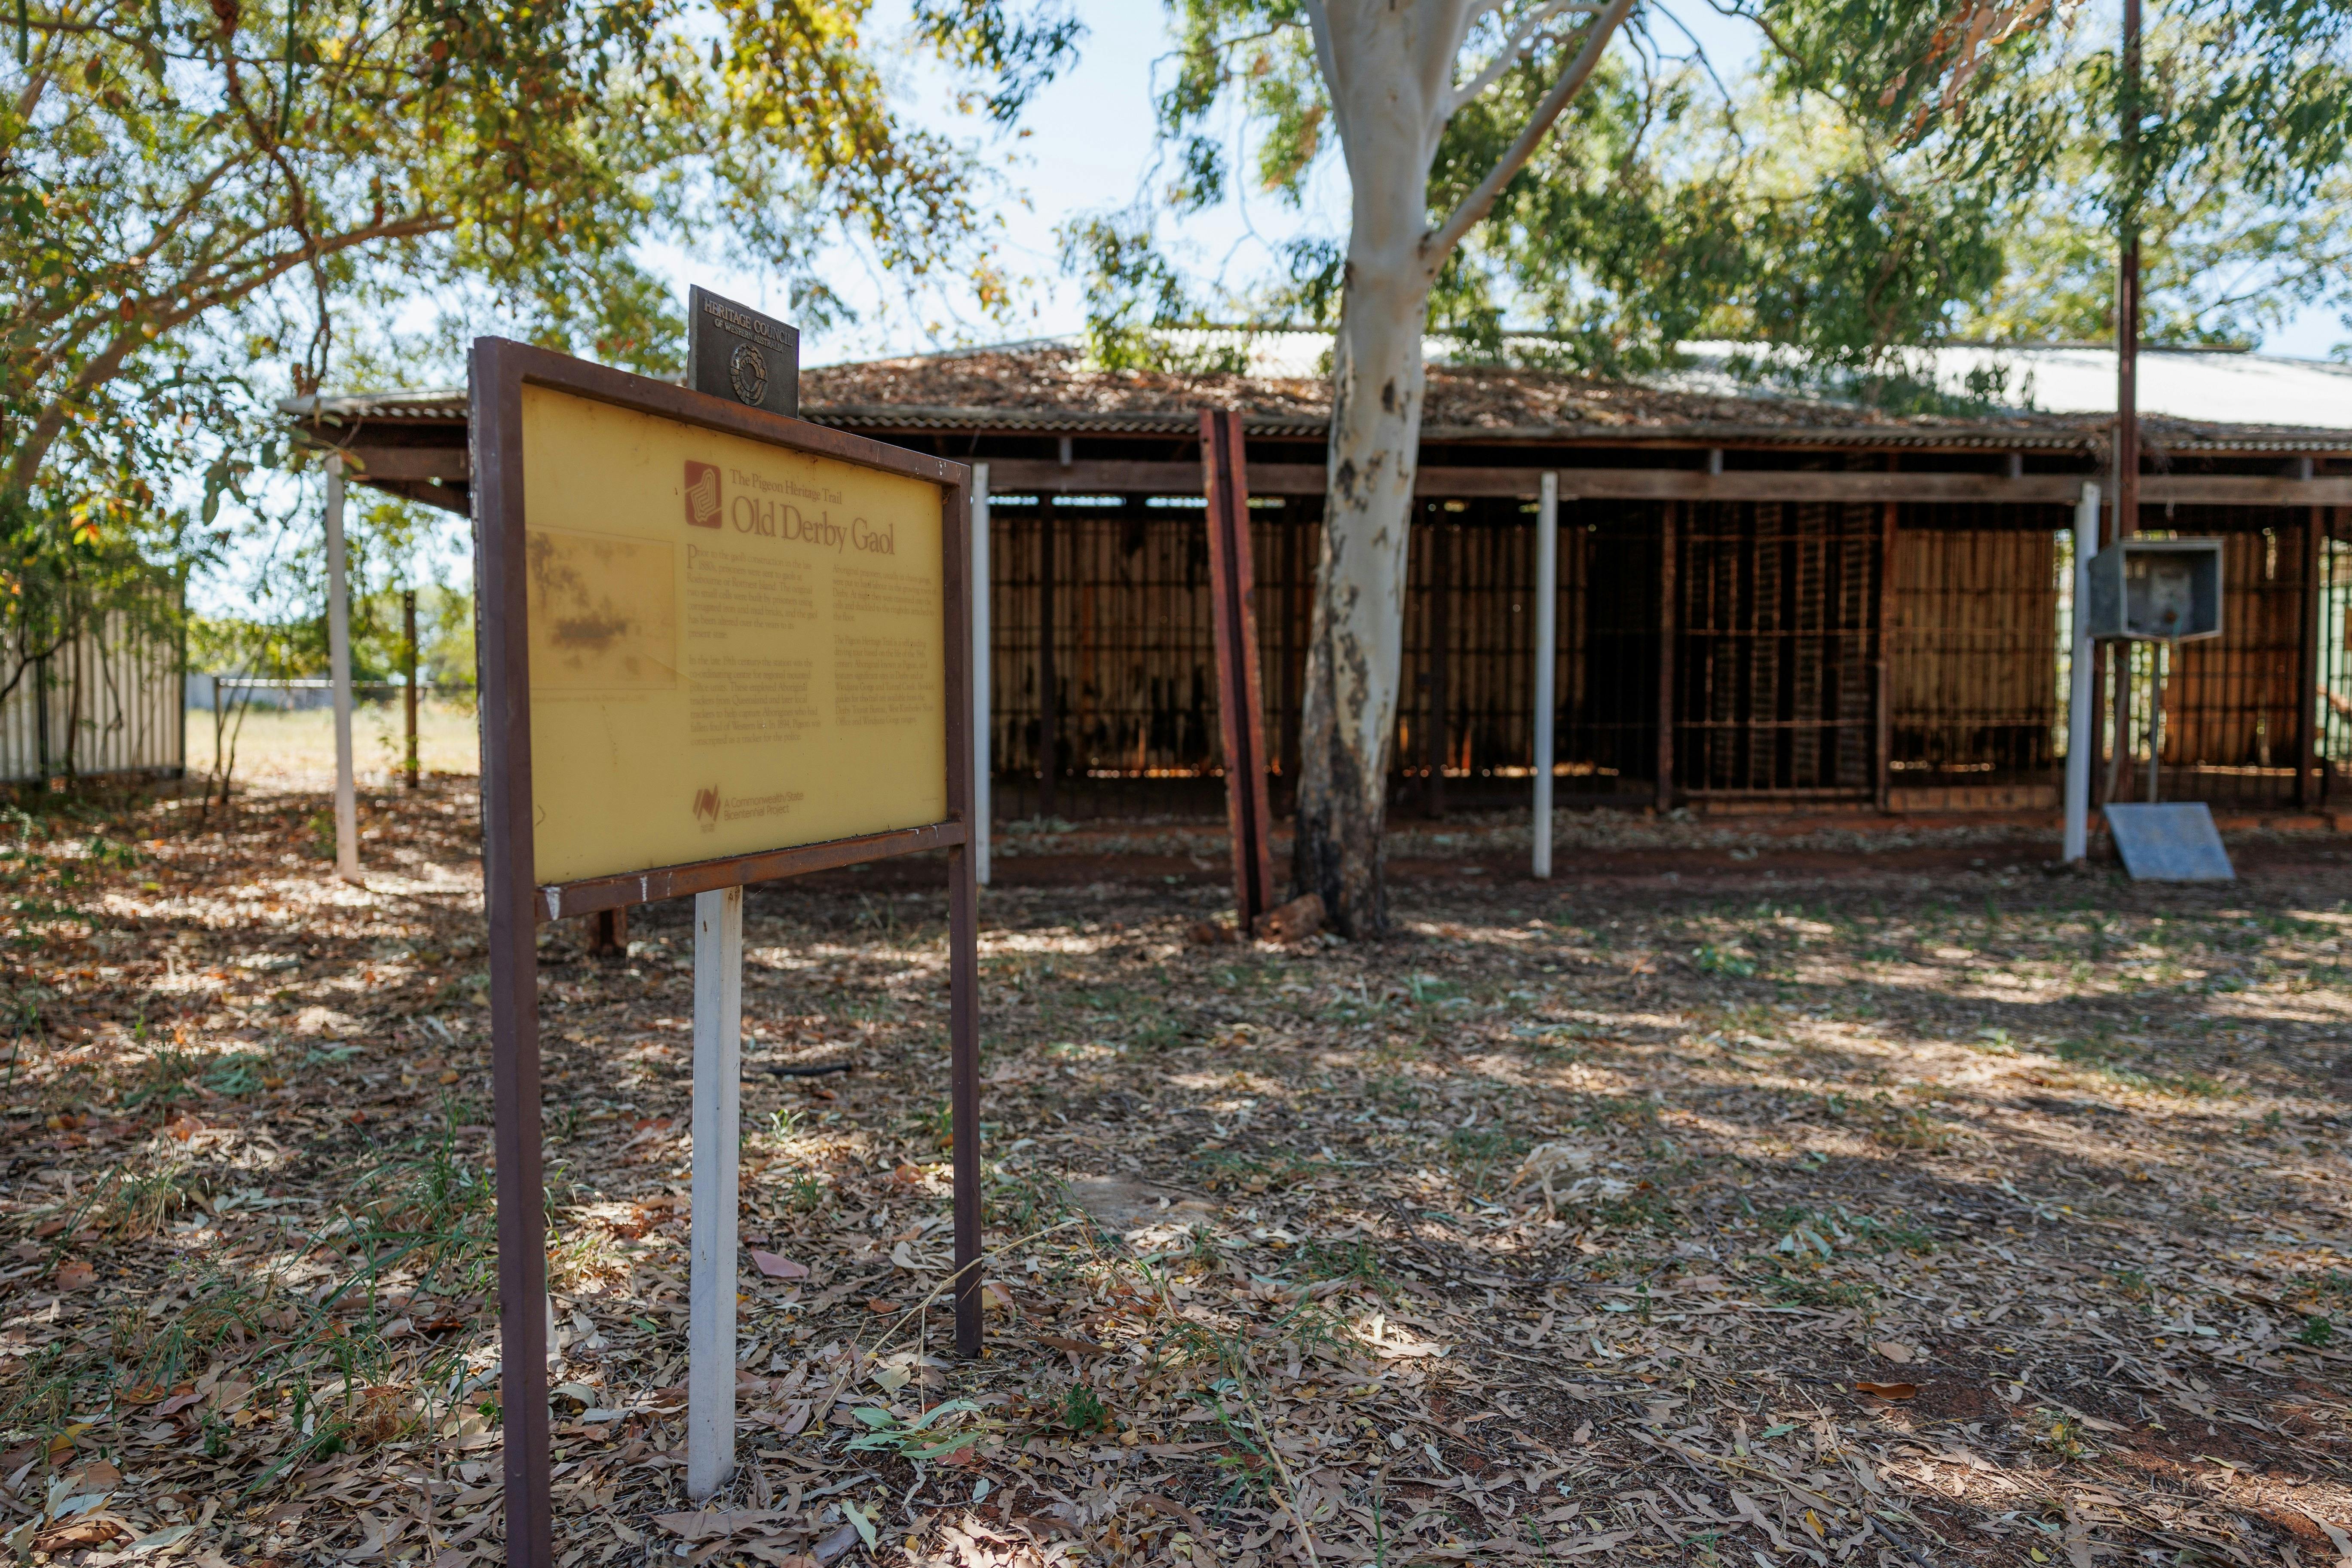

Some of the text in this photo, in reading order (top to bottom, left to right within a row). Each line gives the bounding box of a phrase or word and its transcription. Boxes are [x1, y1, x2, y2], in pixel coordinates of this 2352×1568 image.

[703, 297, 793, 346] HERITAGE COUNCIL
[714, 318, 783, 353] OF WESTERN AUSTRALIA
[730, 469, 842, 505] The Pigeon Heritage Trail
[732, 496, 895, 554] Old Derby Gaol
[778, 682, 807, 693] Aboriginal
[732, 695, 767, 706] Queensland
[763, 707, 793, 718] Aborigines
[793, 719, 810, 729] Pigeon
[724, 791, 804, 808] A Commonwealth/State
[724, 805, 789, 821] Bicentennial Project
